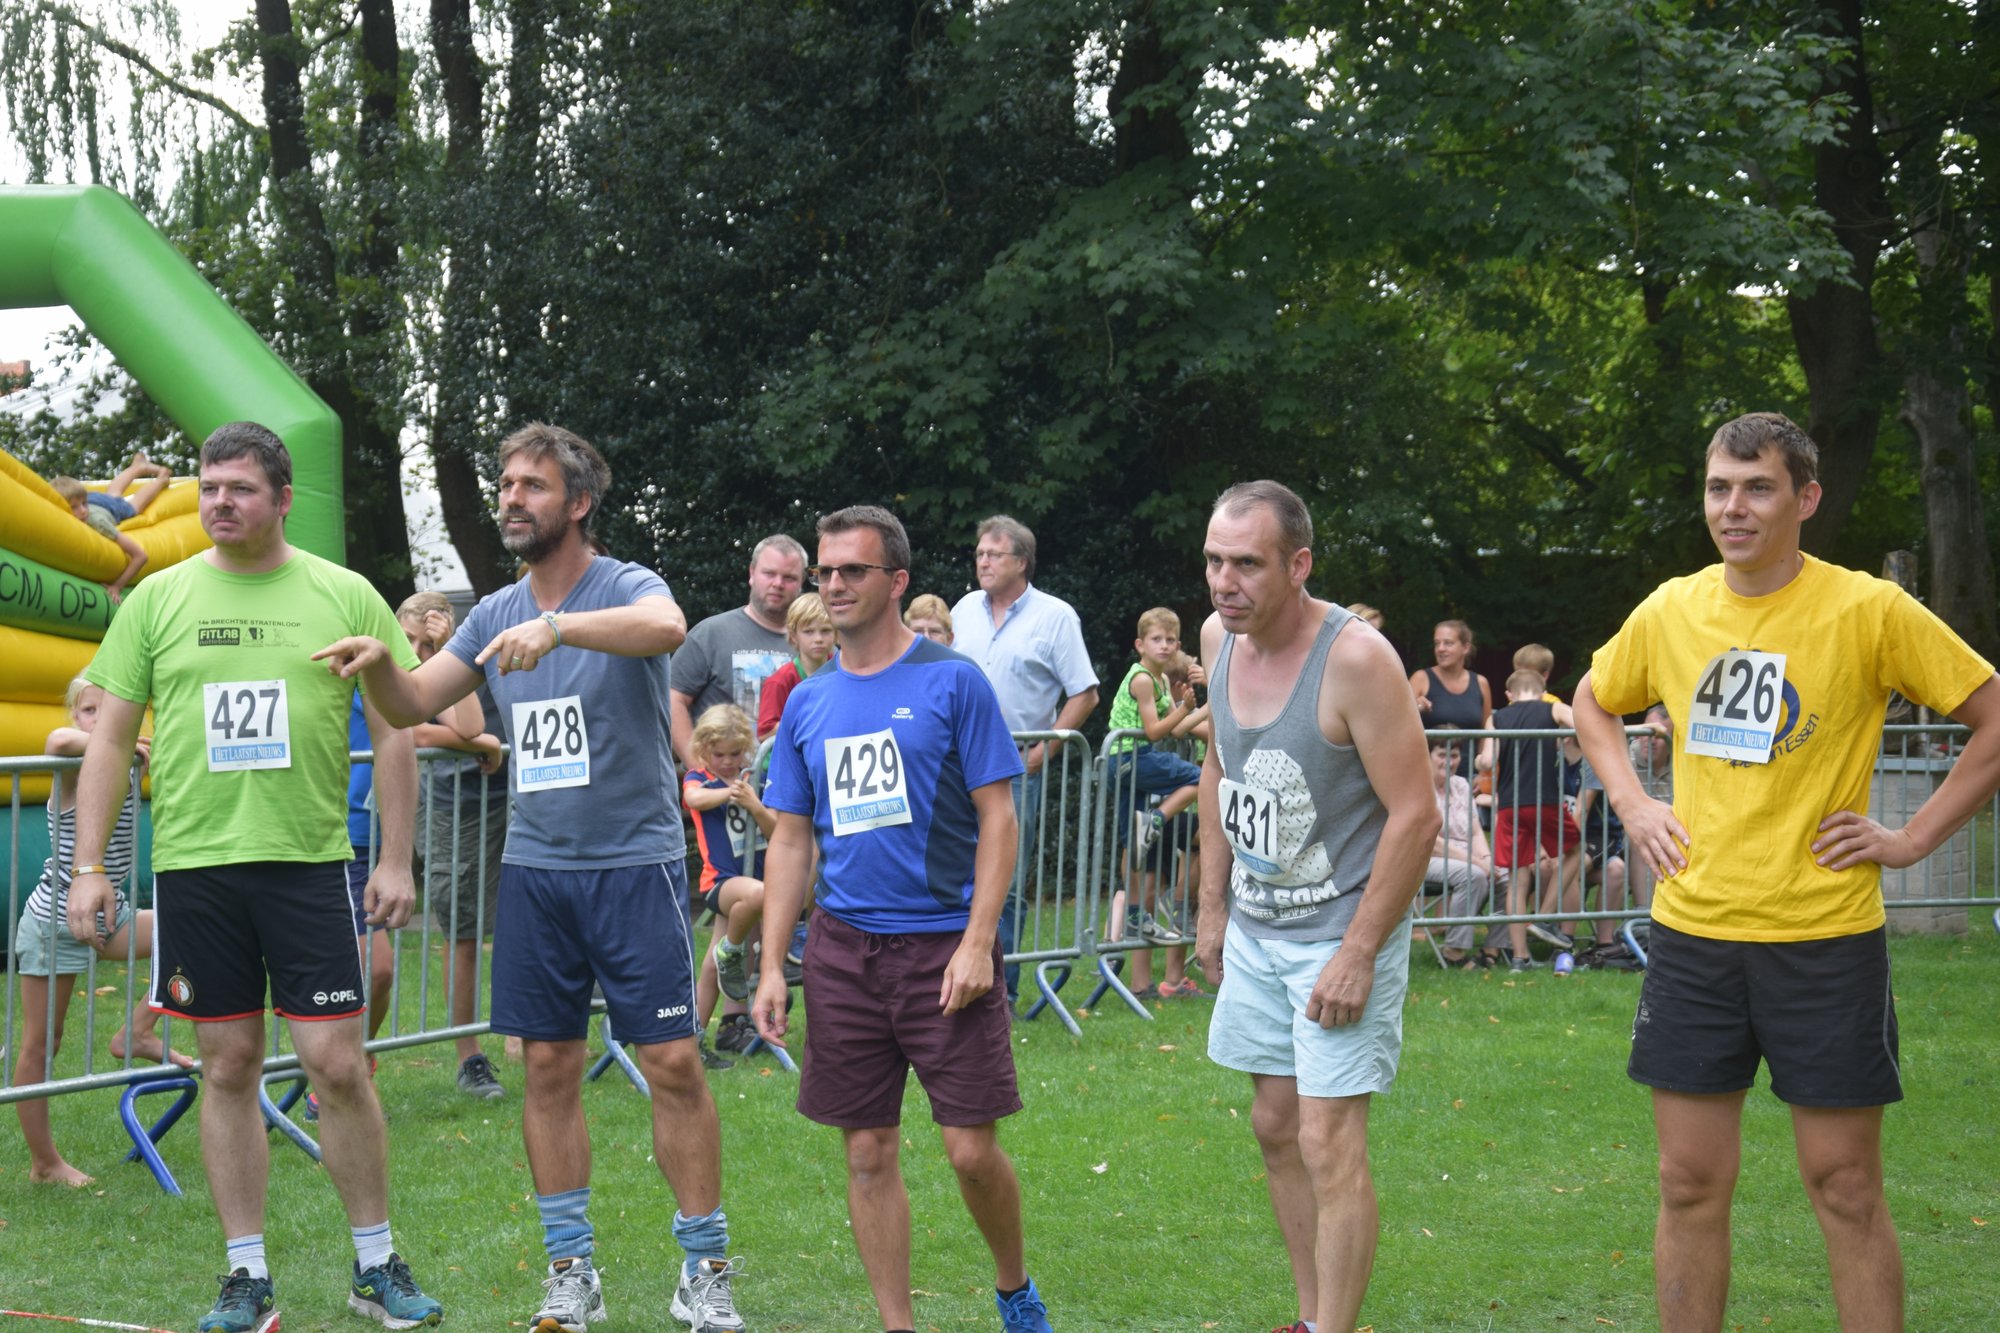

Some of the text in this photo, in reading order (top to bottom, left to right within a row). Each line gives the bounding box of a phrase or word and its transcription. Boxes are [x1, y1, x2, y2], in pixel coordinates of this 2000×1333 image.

[200, 629, 239, 640] FITLAB
[250, 619, 301, 627] STRATENLOOP
[1696, 658, 1777, 723] 426
[211, 688, 280, 739] 427
[521, 705, 583, 760] 428
[1695, 724, 1769, 749] HET LAATSTE NIEUWS
[1785, 713, 1820, 753] Essen
[214, 744, 283, 761] HET LAATSTE NIEUWS
[835, 738, 899, 799] 429
[839, 799, 903, 823] HET LAATSTE NIEUWS
[1225, 790, 1271, 856] 431
[330, 990, 358, 1003] OPEL
[657, 1005, 688, 1018] JAKO
